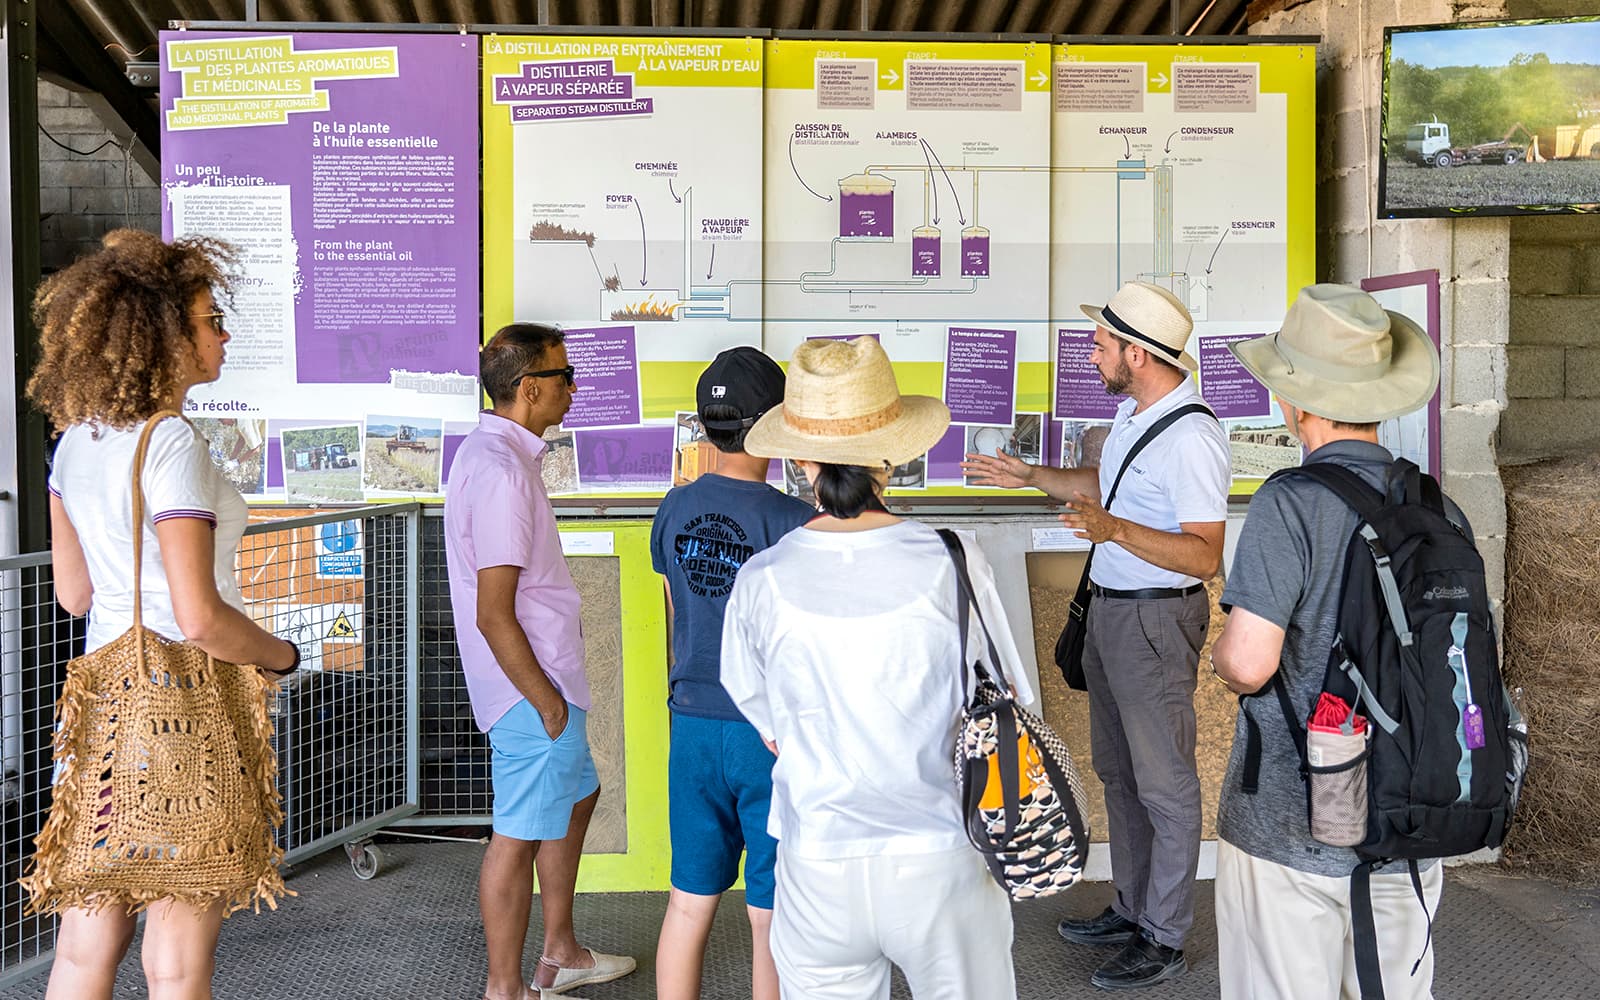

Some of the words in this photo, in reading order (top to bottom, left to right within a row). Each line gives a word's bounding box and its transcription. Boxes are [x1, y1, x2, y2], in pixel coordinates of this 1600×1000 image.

[176, 50, 192, 62] LA
[196, 46, 282, 62] DISTILLATION
[487, 43, 503, 54] LA
[506, 42, 591, 55] DISTILLATION
[594, 44, 617, 56] PAR
[622, 41, 722, 56] ENTRAÎNEMENT
[206, 63, 232, 76] DES
[236, 61, 294, 75] PLANTES
[298, 56, 390, 72] AROMATIQUES
[638, 56, 648, 70] À
[650, 60, 666, 71] LA
[667, 60, 719, 71] VAPEUR
[722, 60, 760, 72] D'EAU
[531, 64, 607, 79] DISTILLERIE
[194, 80, 208, 92] ET
[213, 76, 301, 92] MÉDICINALES
[501, 81, 511, 96] À
[512, 83, 563, 96] VAPEUR
[566, 79, 624, 95] SÉPARÉE
[182, 104, 199, 113] THE
[201, 102, 259, 112] DISTILLATION
[261, 100, 272, 109] OF
[275, 98, 320, 108] AROMATIC
[516, 107, 566, 117] SEPARATED
[568, 105, 598, 115] STEAM
[600, 102, 648, 113] DISTILLERY
[174, 115, 192, 124] AND
[194, 113, 242, 123] MEDICINAL
[244, 111, 279, 120] PLANTS
[313, 122, 330, 133] De
[333, 122, 345, 133] la
[349, 122, 390, 135] plante
[1099, 126, 1147, 134] ÉCHANGEUR
[313, 135, 320, 146] à
[324, 136, 364, 147] l'huile
[367, 136, 438, 147] essentielle
[176, 164, 192, 176] Un
[197, 166, 220, 177] peu
[635, 161, 678, 170] CHEMINÉE
[202, 175, 276, 186] d'histoire...
[702, 217, 749, 226] CHAUDIÈRE
[314, 240, 342, 250] From
[345, 240, 362, 250] the
[365, 240, 392, 251] plant
[314, 252, 324, 260] to
[328, 251, 344, 260] the
[347, 251, 396, 261] essential
[399, 252, 412, 261] oil
[202, 400, 260, 411] récolte...
[684, 516, 702, 532] SAN
[704, 513, 747, 542] FRANCISCO
[696, 528, 733, 541] ORIGINAL
[691, 572, 704, 583] DRY
[706, 575, 725, 586] GOODS
[711, 582, 734, 598] MAD
[1433, 586, 1467, 594] Columbia
